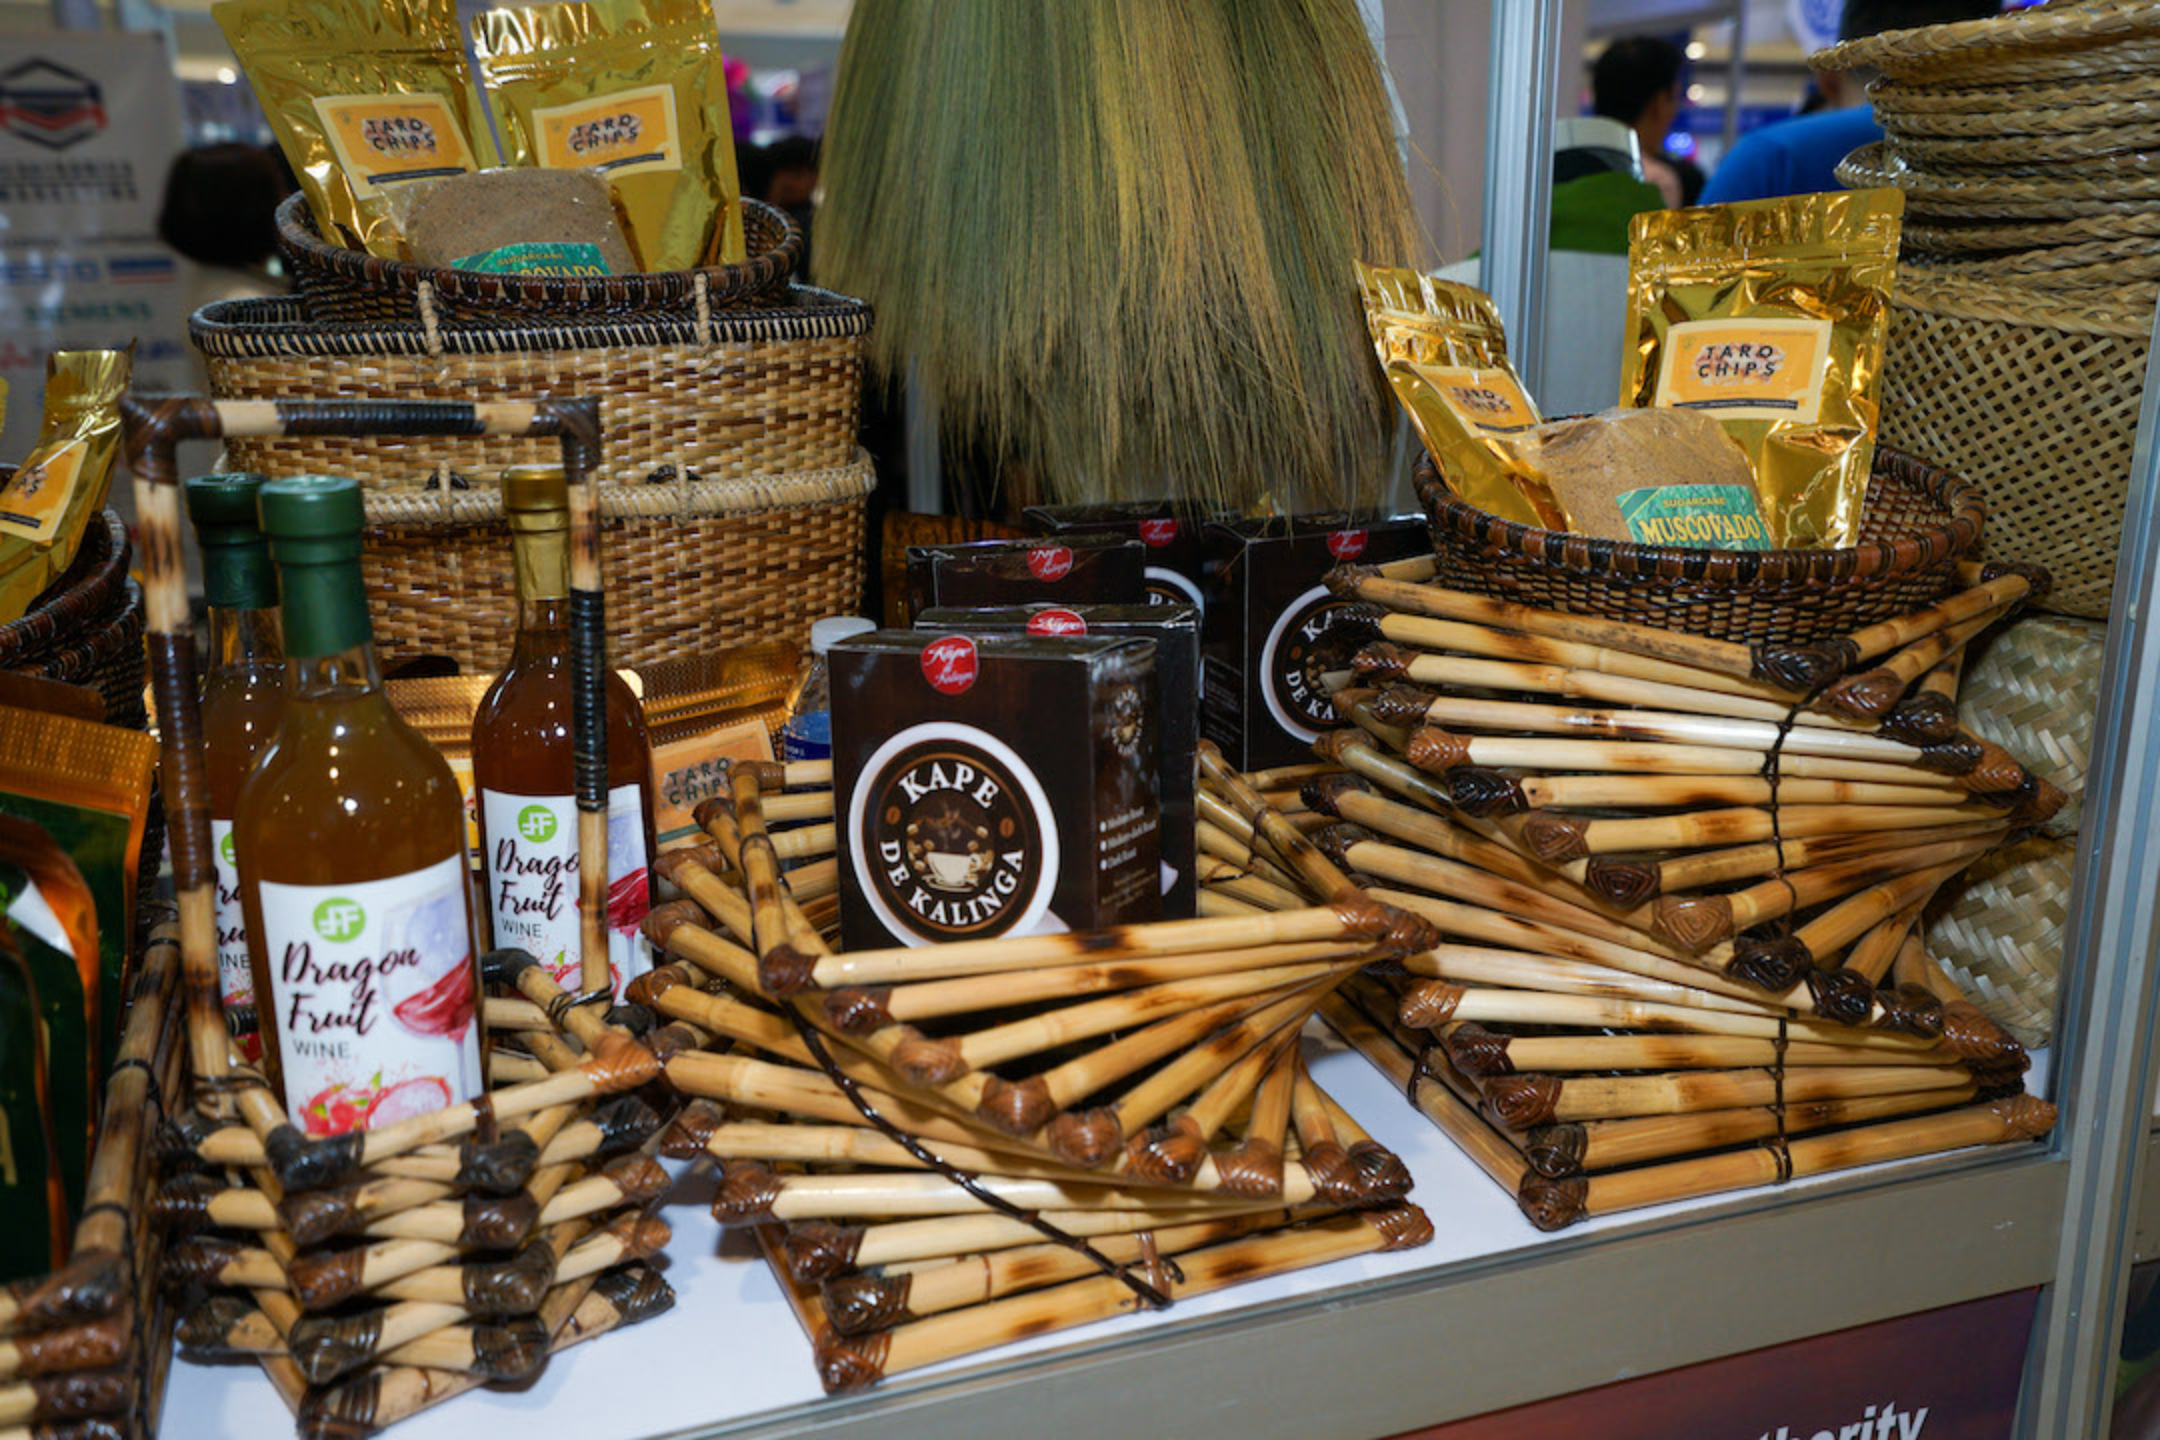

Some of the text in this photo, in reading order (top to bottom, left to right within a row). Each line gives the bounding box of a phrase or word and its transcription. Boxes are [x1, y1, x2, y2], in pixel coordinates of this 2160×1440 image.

[366, 118, 423, 132] TARO
[576, 114, 632, 137] TARO
[373, 134, 436, 150] CHIPS
[574, 127, 638, 152] CHIPS
[1705, 344, 1774, 359] TARO
[1698, 362, 1775, 377] CHIPS
[1663, 497, 1727, 508] SUGARCANE
[1638, 514, 1762, 545] MUSCOVADO
[668, 757, 731, 786] TARO
[669, 778, 722, 805] CHIP
[899, 762, 999, 808] KAPE
[496, 838, 580, 891] Drago
[880, 840, 1025, 926] DE KALINGA
[499, 879, 564, 921] Fruit
[502, 918, 542, 938] WINE
[219, 953, 250, 969] INE
[282, 941, 421, 1000] Dragon
[289, 989, 379, 1037] Fruit
[293, 1039, 352, 1060] WINE
